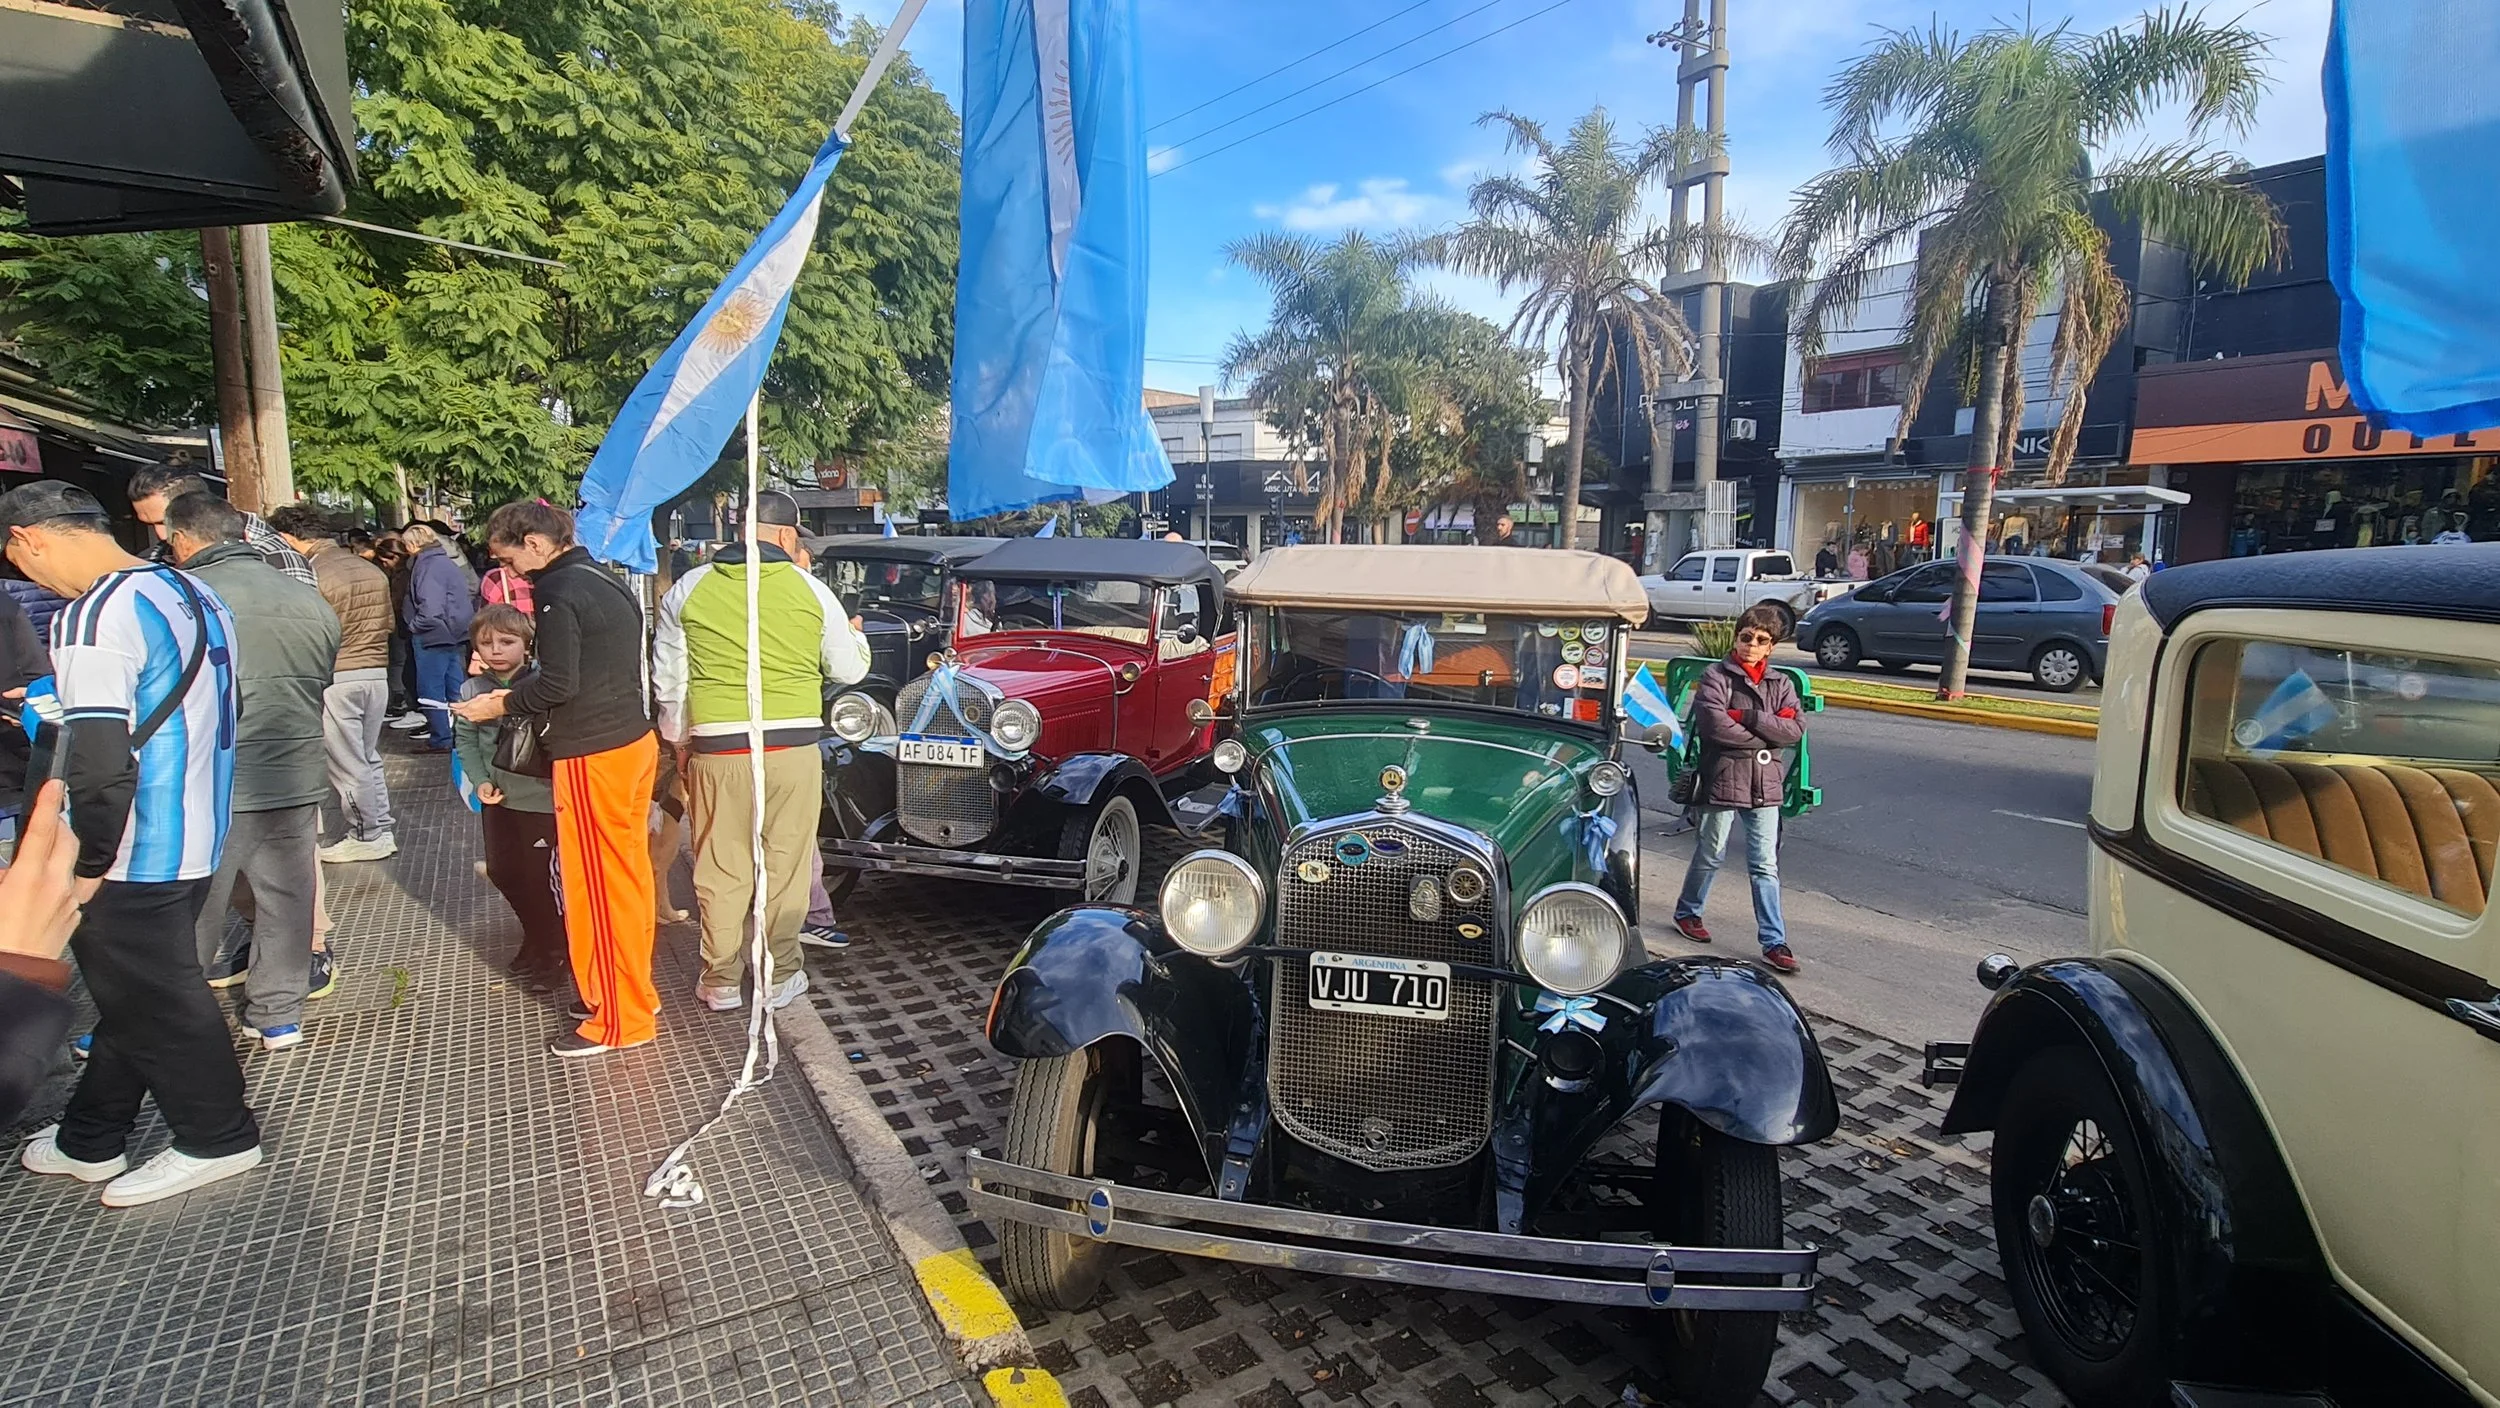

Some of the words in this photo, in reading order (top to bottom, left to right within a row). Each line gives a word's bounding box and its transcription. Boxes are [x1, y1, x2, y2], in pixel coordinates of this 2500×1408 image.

[904, 743, 922, 759] AF
[927, 744, 954, 762] 084
[960, 747, 978, 763] TF
[1352, 958, 1408, 971] ARGENTINA
[1316, 967, 1369, 1002] VJU
[1389, 973, 1443, 1008] 710
